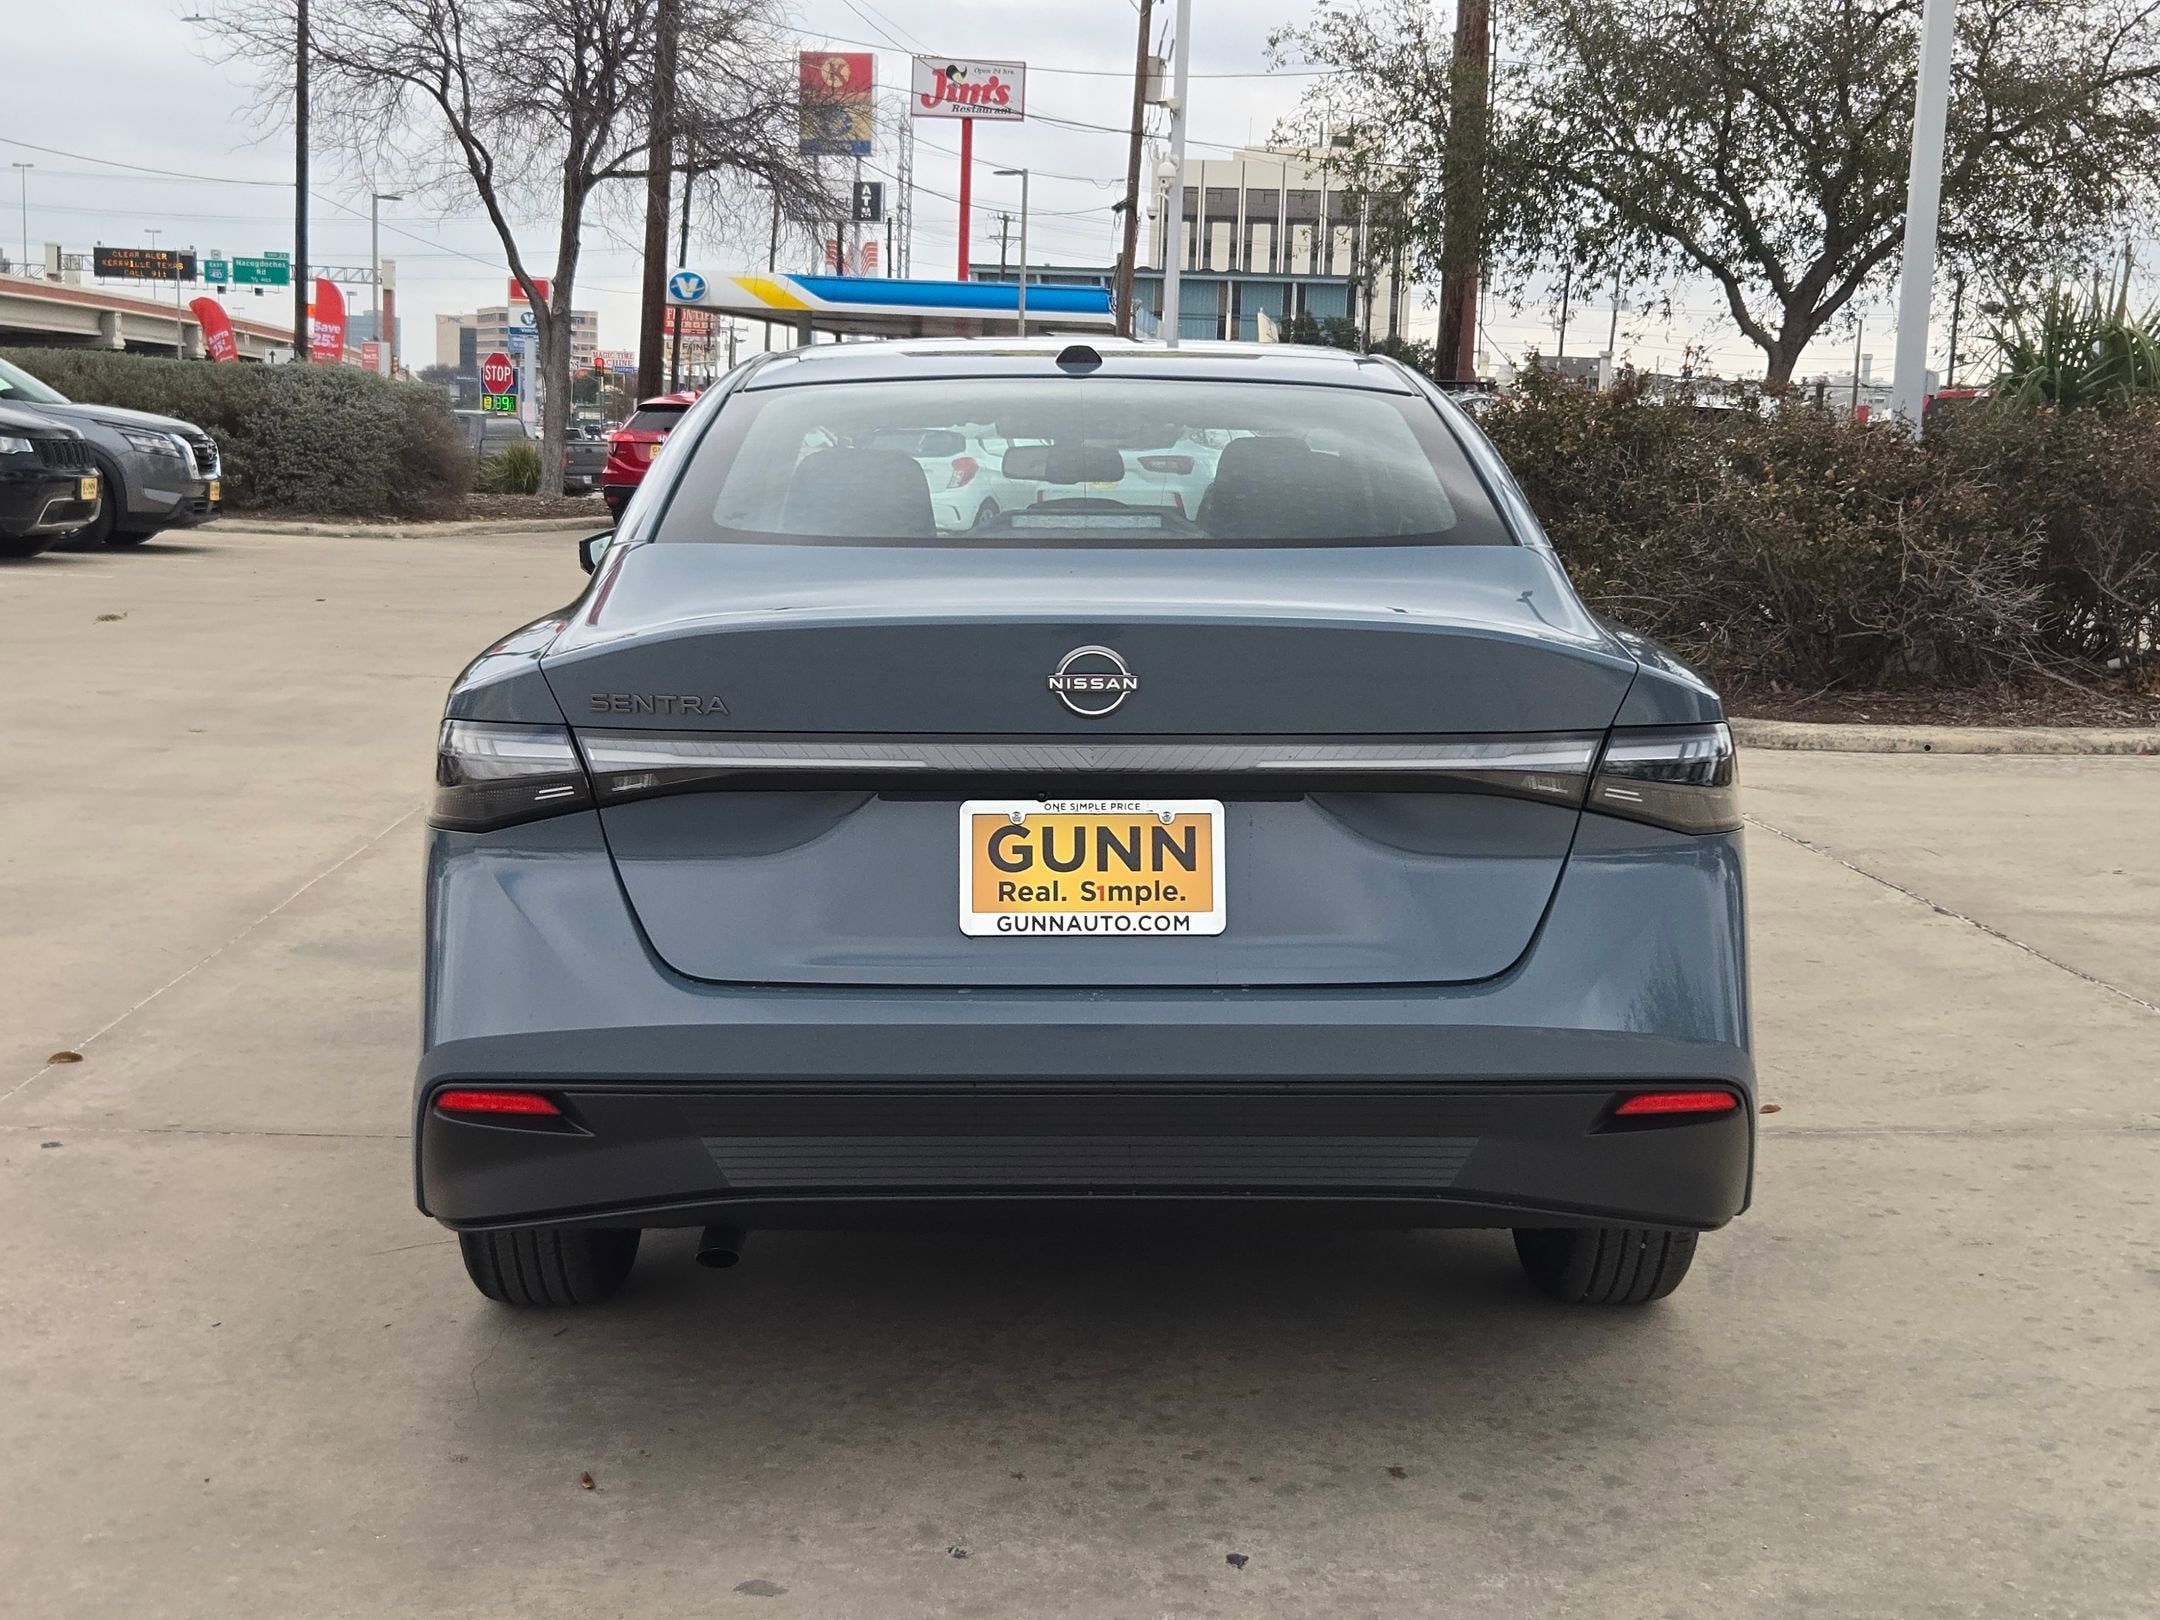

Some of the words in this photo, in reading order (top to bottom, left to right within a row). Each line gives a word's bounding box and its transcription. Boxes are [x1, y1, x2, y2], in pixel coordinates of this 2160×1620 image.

[920, 68, 1011, 109] Jim's
[951, 104, 1012, 115] Restaurant
[314, 321, 341, 334] Save
[484, 365, 511, 382] STOP
[1049, 677, 1138, 690] NISSAN
[590, 693, 731, 716] SENTRA
[1044, 802, 1067, 812] ONE
[1070, 802, 1107, 812] SIMPLE
[1110, 802, 1141, 811] PRICE
[987, 824, 1197, 873] GUNN
[998, 880, 1067, 902] Real.
[996, 914, 1191, 932] GUNNAUTO.COM
